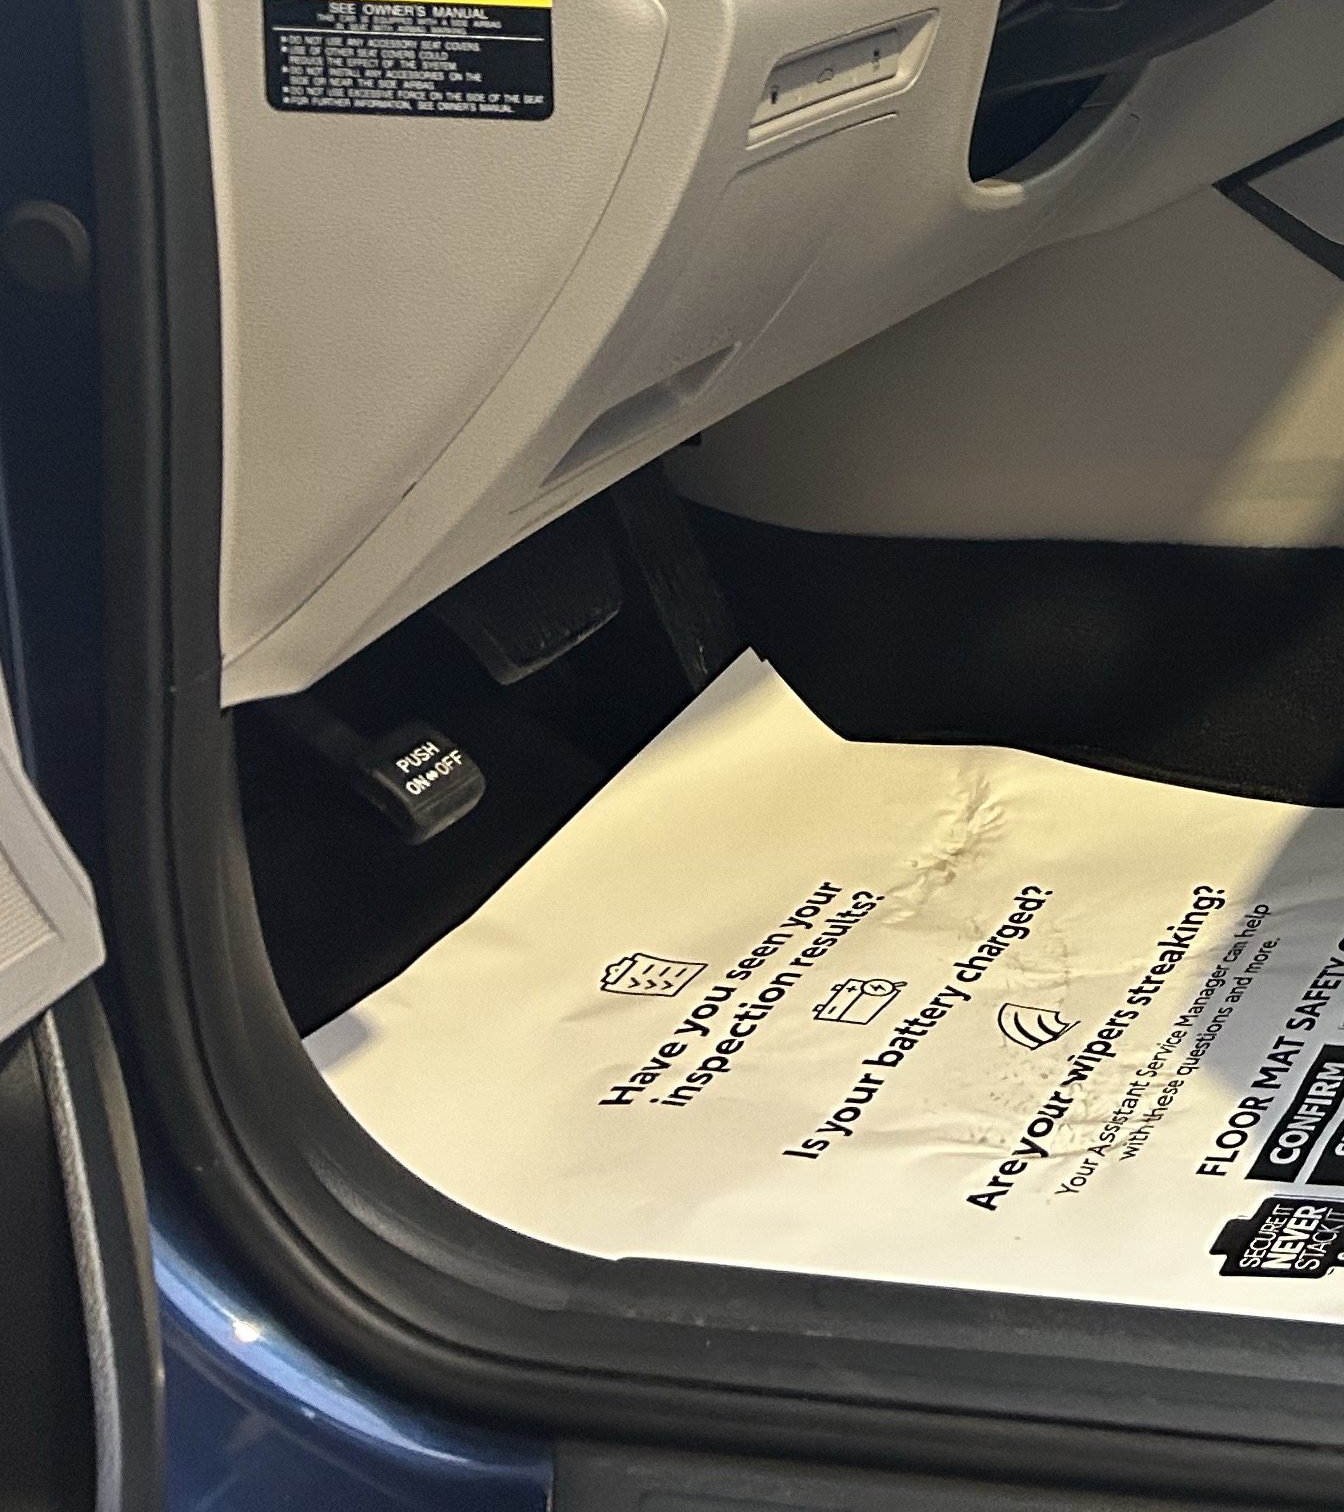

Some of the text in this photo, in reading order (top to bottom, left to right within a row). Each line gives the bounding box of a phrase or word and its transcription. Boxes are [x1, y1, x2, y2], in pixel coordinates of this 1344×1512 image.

[328, 1, 489, 20] SEE OWNER'S MANUAL
[396, 741, 440, 774] PUSH
[598, 881, 843, 1106] Have you seen your
[649, 890, 886, 1107] inspection results?
[781, 885, 1054, 1160] Is your battery charged?
[966, 885, 1226, 1212] Are your wipers streaking?
[1054, 902, 1270, 1196] Your Assistant Service Manager can help
[1119, 937, 1281, 1162] with these questions and more.
[1195, 1096, 1276, 1177] FLOOR
[1251, 1035, 1305, 1090] MAT
[1239, 1203, 1295, 1268] SECURE IT
[1260, 1205, 1328, 1269] NEVER
[1294, 1223, 1344, 1270] STACK
